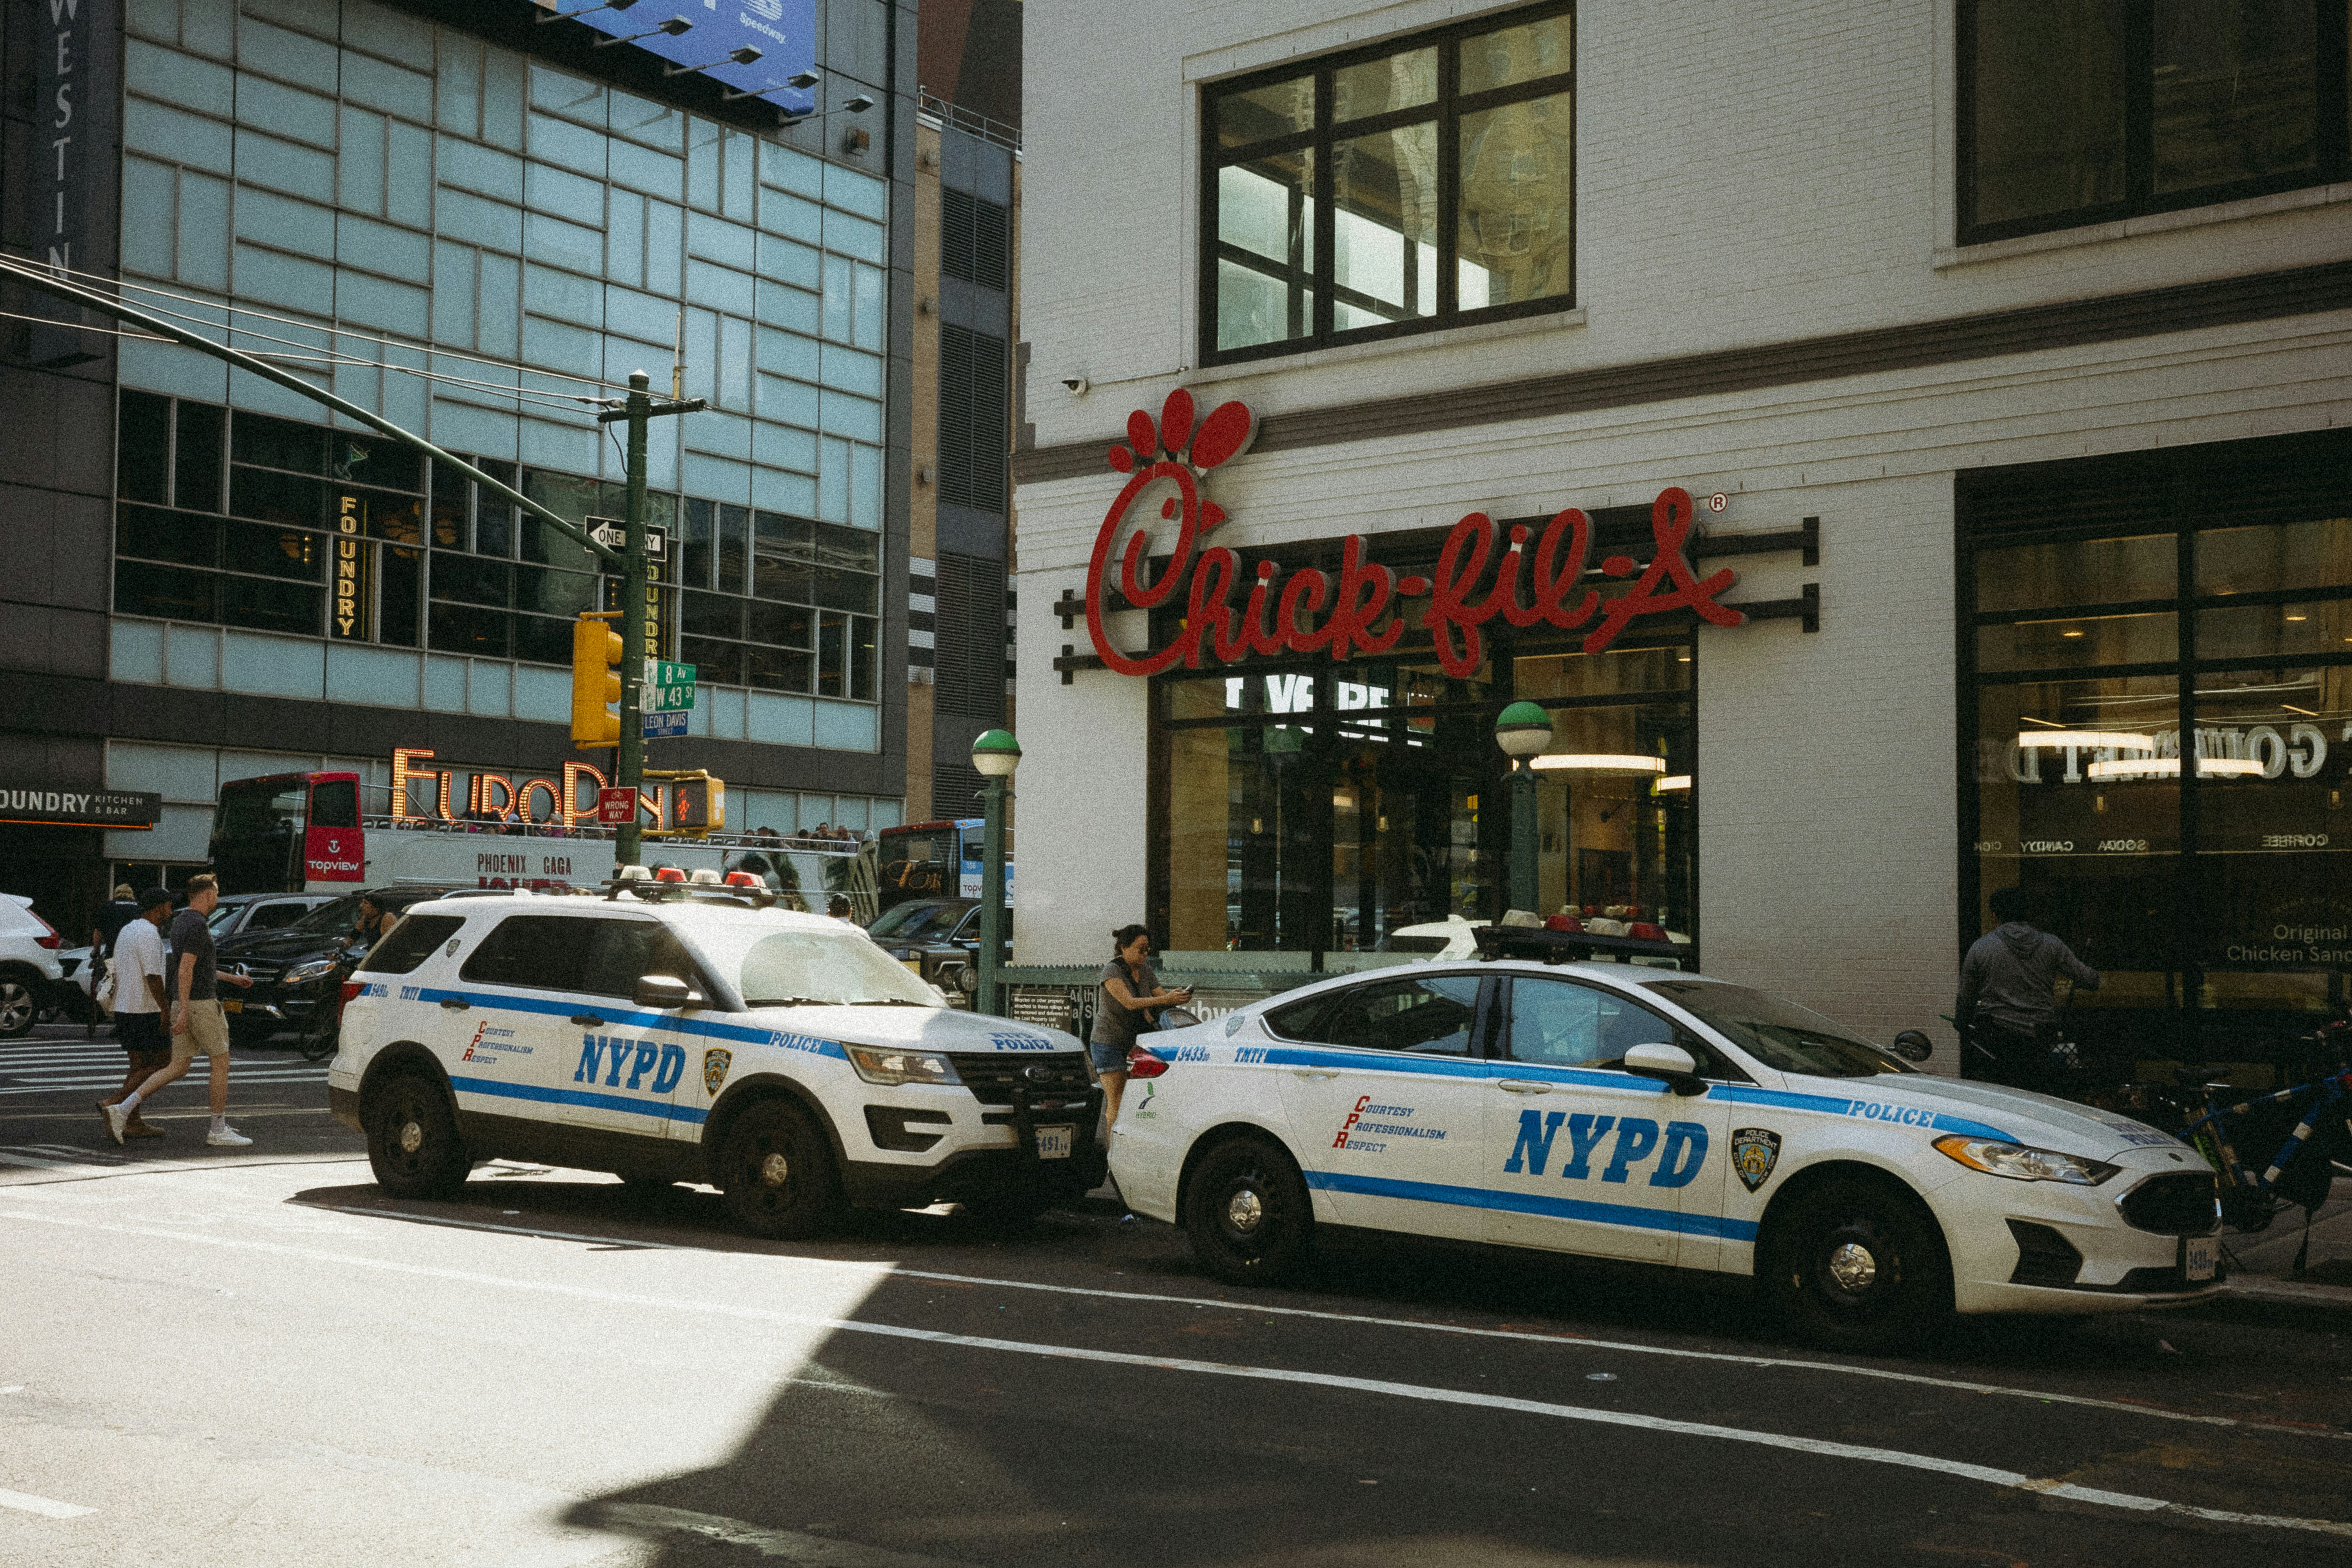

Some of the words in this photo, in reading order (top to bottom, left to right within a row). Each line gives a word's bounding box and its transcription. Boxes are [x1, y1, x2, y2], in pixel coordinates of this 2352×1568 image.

[598, 530, 621, 544] ONE
[338, 496, 356, 635] FOUNDRY
[1086, 461, 1748, 678] Chick-fil-A
[665, 665, 672, 684] 8
[657, 688, 665, 707] W
[669, 687, 682, 706] 43
[645, 715, 663, 728] LEON
[667, 713, 686, 727] DAVIS
[95, 795, 143, 805] KITCHEN
[604, 801, 629, 809] WRONG
[106, 806, 127, 815] BAR
[609, 811, 624, 819] WAY
[478, 853, 526, 873] PHOENIX
[543, 856, 572, 875] GAGA
[2274, 924, 2348, 944] Original
[2227, 946, 2304, 961] Chicken
[770, 1032, 820, 1053] POLICE
[992, 1039, 1054, 1050] POLICE
[1235, 1047, 1267, 1063] TMTF
[574, 1034, 686, 1094] NYPD
[1849, 1100, 1934, 1127] POLICE
[1745, 1130, 1769, 1139] POLICE
[1504, 1109, 1709, 1188] NYPD
[1735, 1137, 1777, 1149] DEPARTMENT
